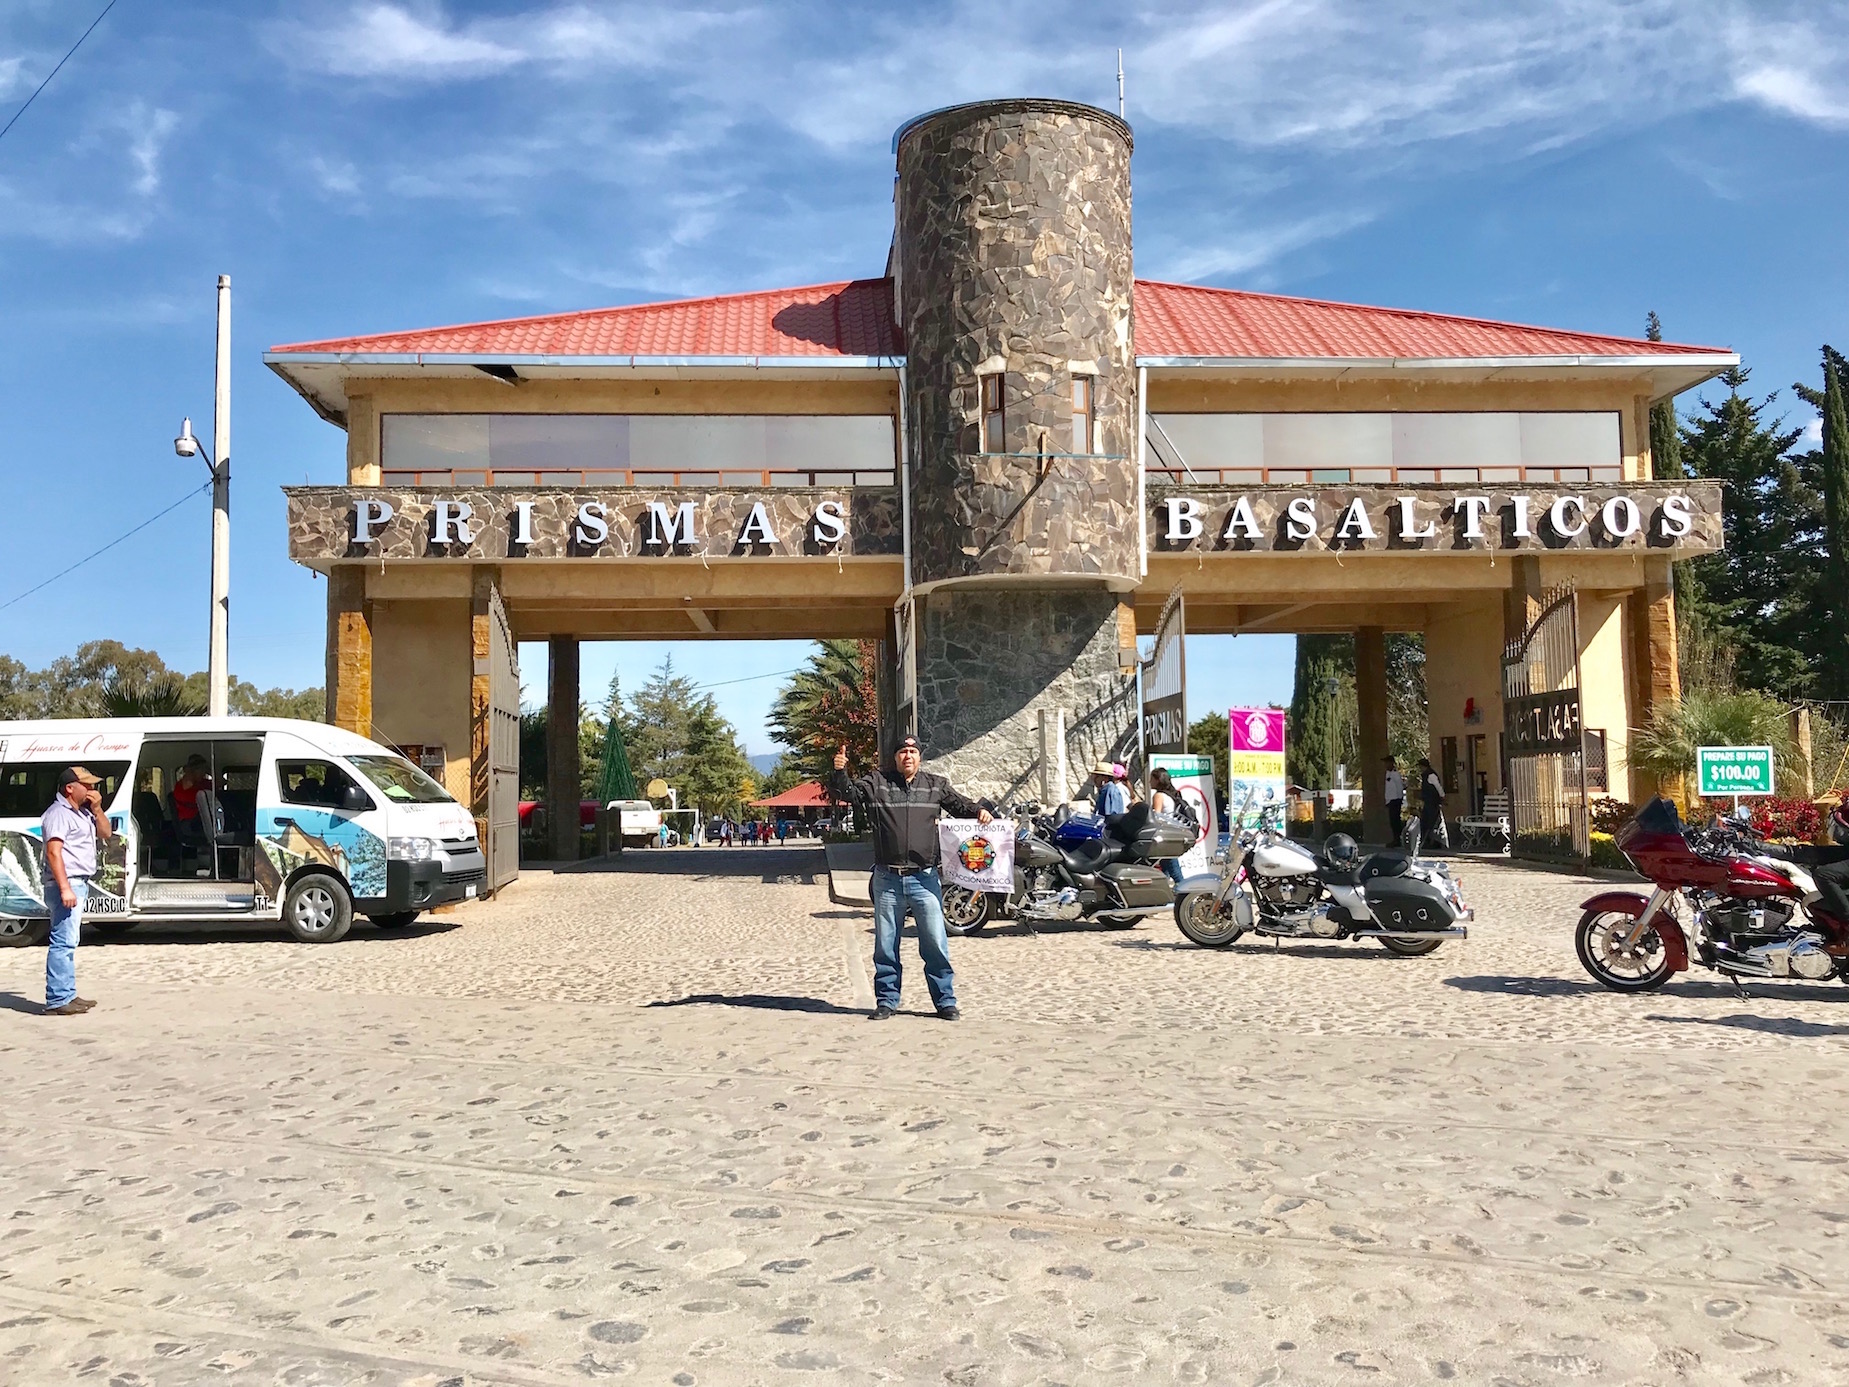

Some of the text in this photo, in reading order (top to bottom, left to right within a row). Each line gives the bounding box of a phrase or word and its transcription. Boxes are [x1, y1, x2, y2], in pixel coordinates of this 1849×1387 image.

[350, 495, 1693, 545] PRISMAS BASALTICOS
[1144, 707, 1182, 747] PRISMAS
[68, 741, 80, 752] de
[83, 734, 130, 753] Ocampo
[1703, 751, 1767, 761] PREPARE SU PAGO
[1183, 760, 1193, 770] SU
[1710, 764, 1761, 781] $100.00
[946, 824, 1006, 832] MOTO TURISTA
